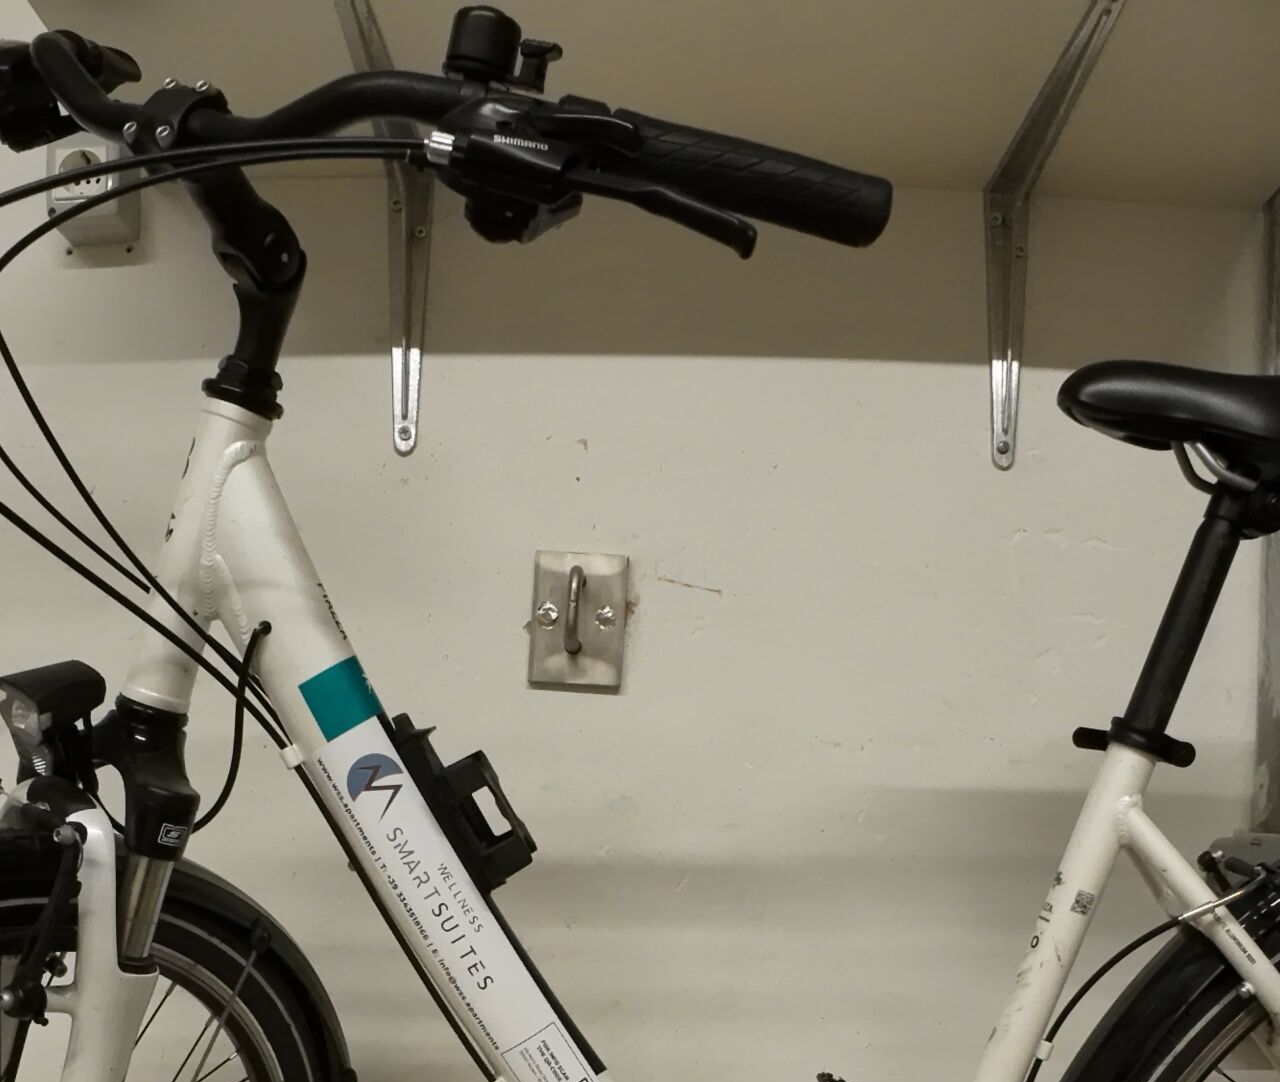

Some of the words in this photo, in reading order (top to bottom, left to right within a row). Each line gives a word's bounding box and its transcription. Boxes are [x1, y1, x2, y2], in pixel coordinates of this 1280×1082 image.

[493, 134, 549, 151] SHIMANO
[317, 757, 377, 856] www.wss.apartments
[438, 958, 500, 1051] info@wss.apartments
[437, 862, 484, 933] WELLNESS
